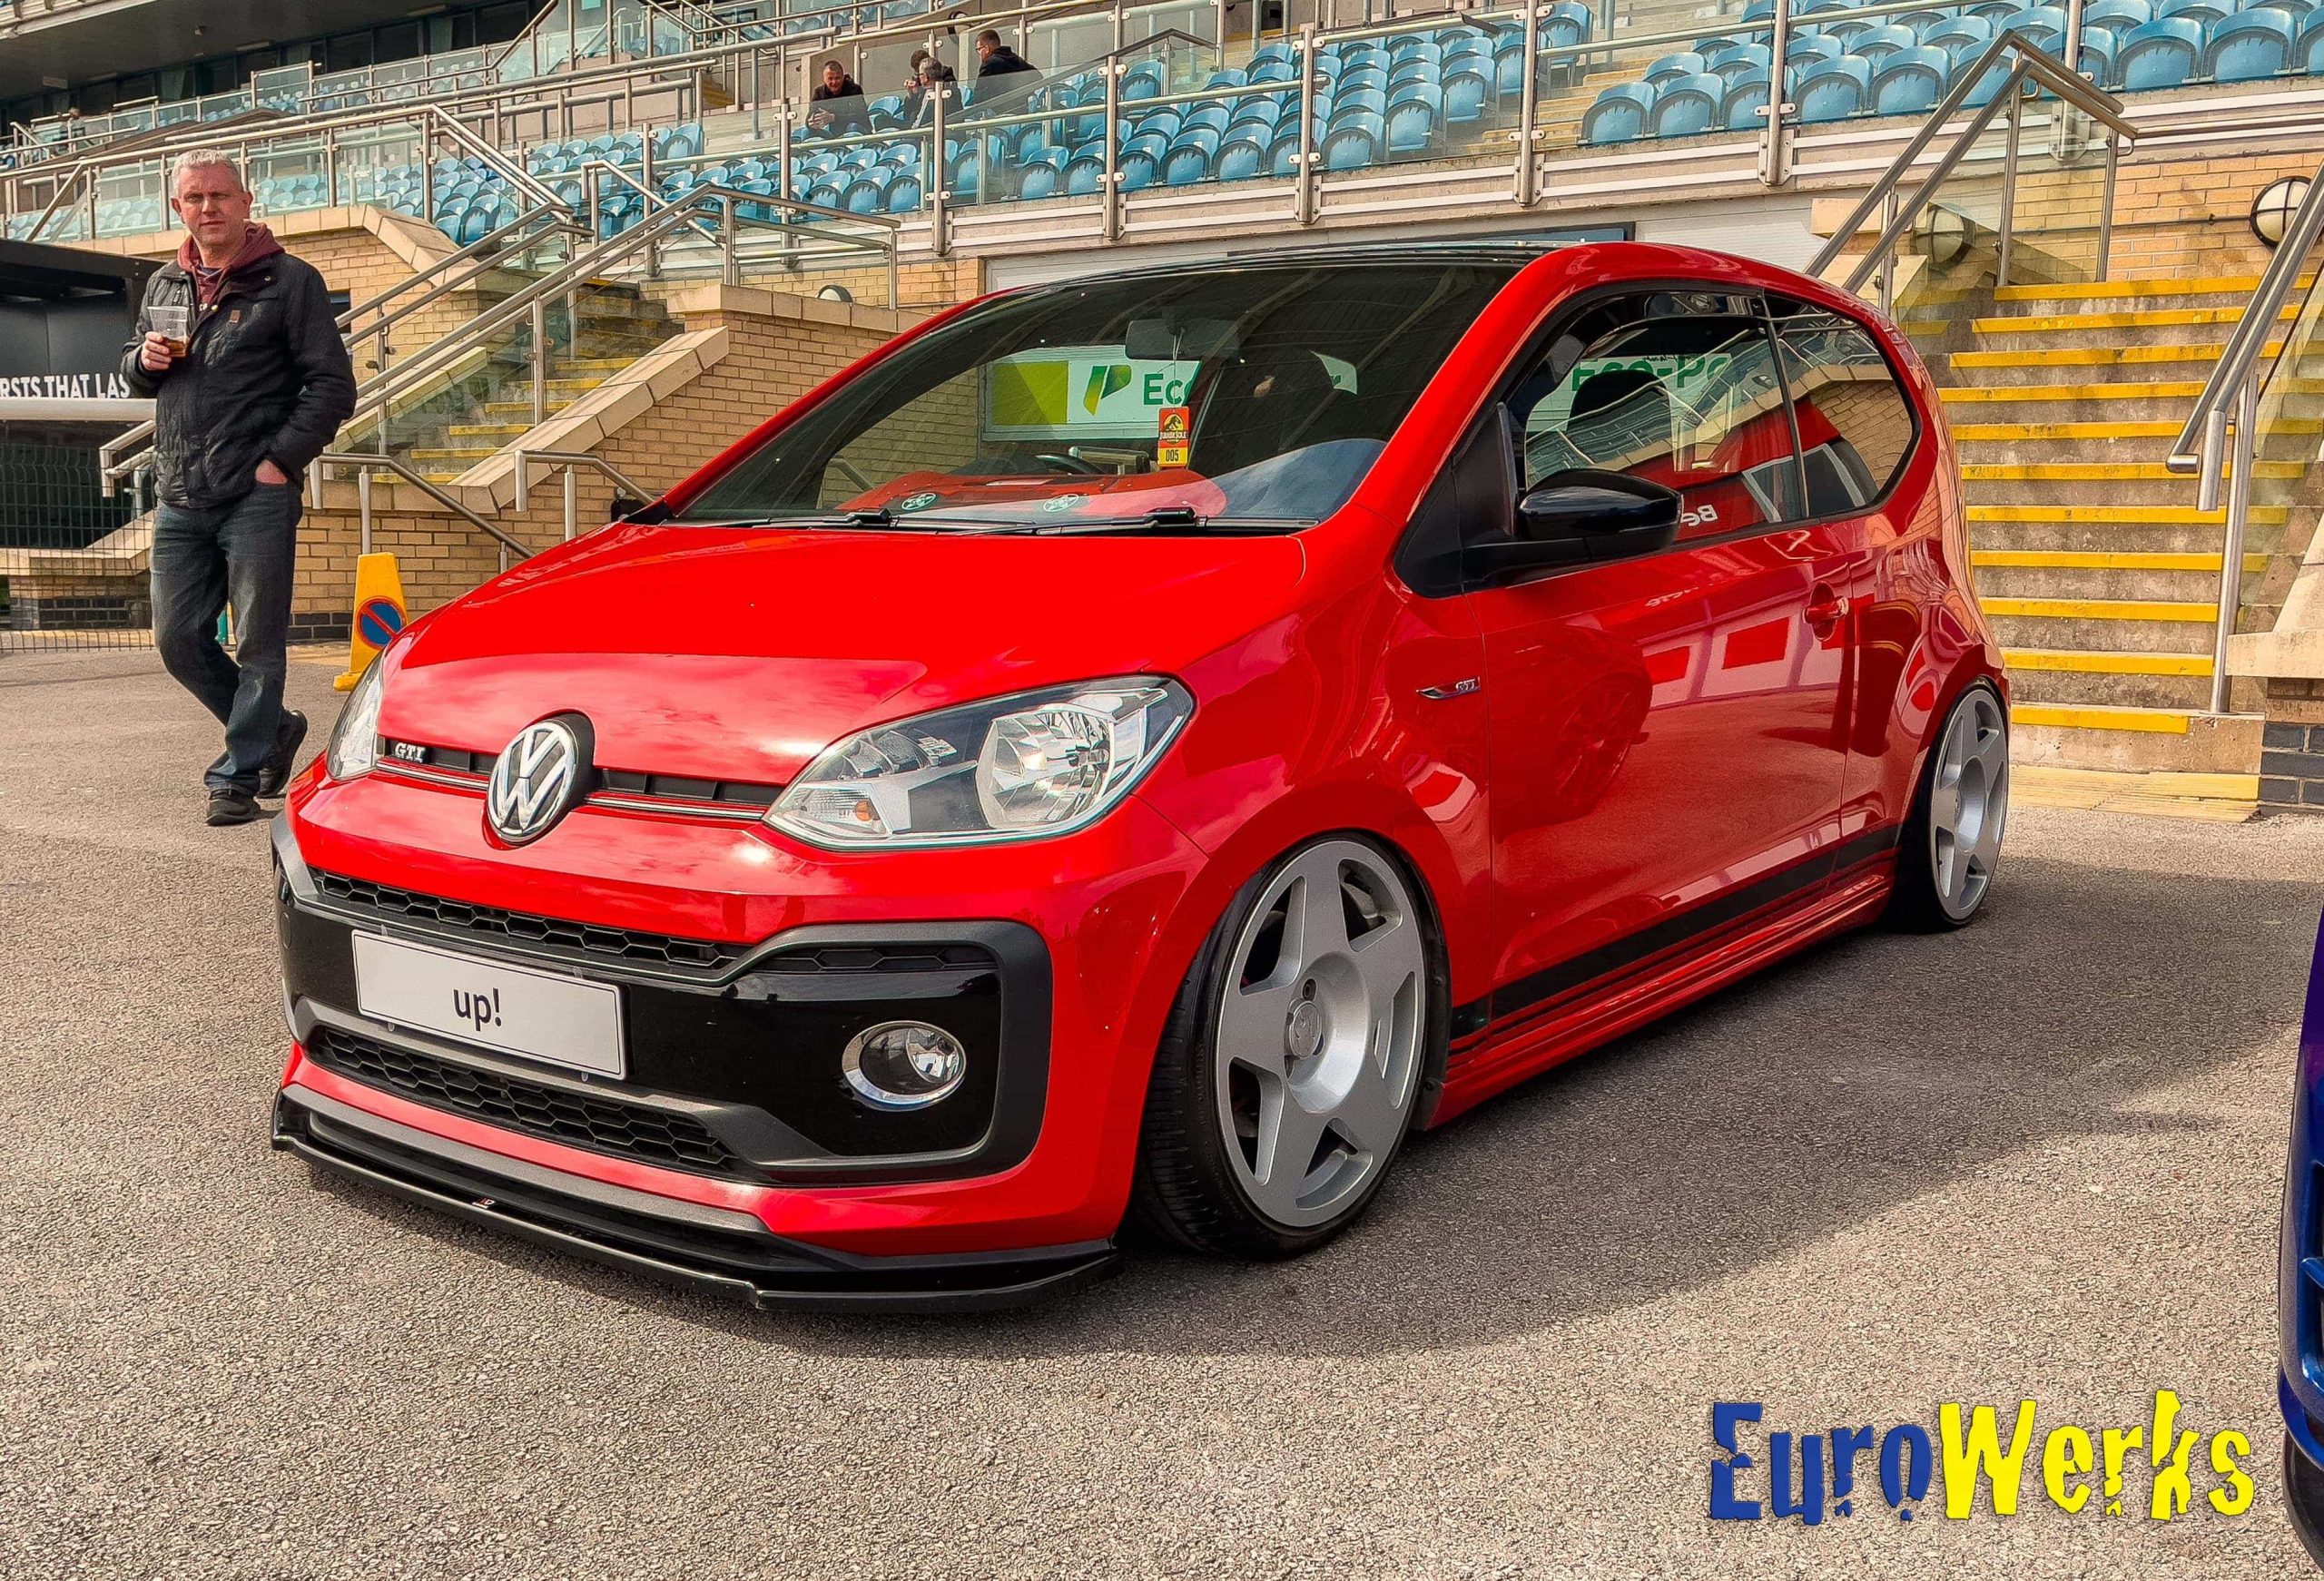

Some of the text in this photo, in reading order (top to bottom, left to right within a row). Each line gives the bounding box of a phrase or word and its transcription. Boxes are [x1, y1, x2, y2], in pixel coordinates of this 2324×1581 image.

[44, 374, 90, 398] THAT
[1166, 449, 1179, 462] 005
[395, 741, 426, 763] GTI
[453, 987, 502, 1032] up!
